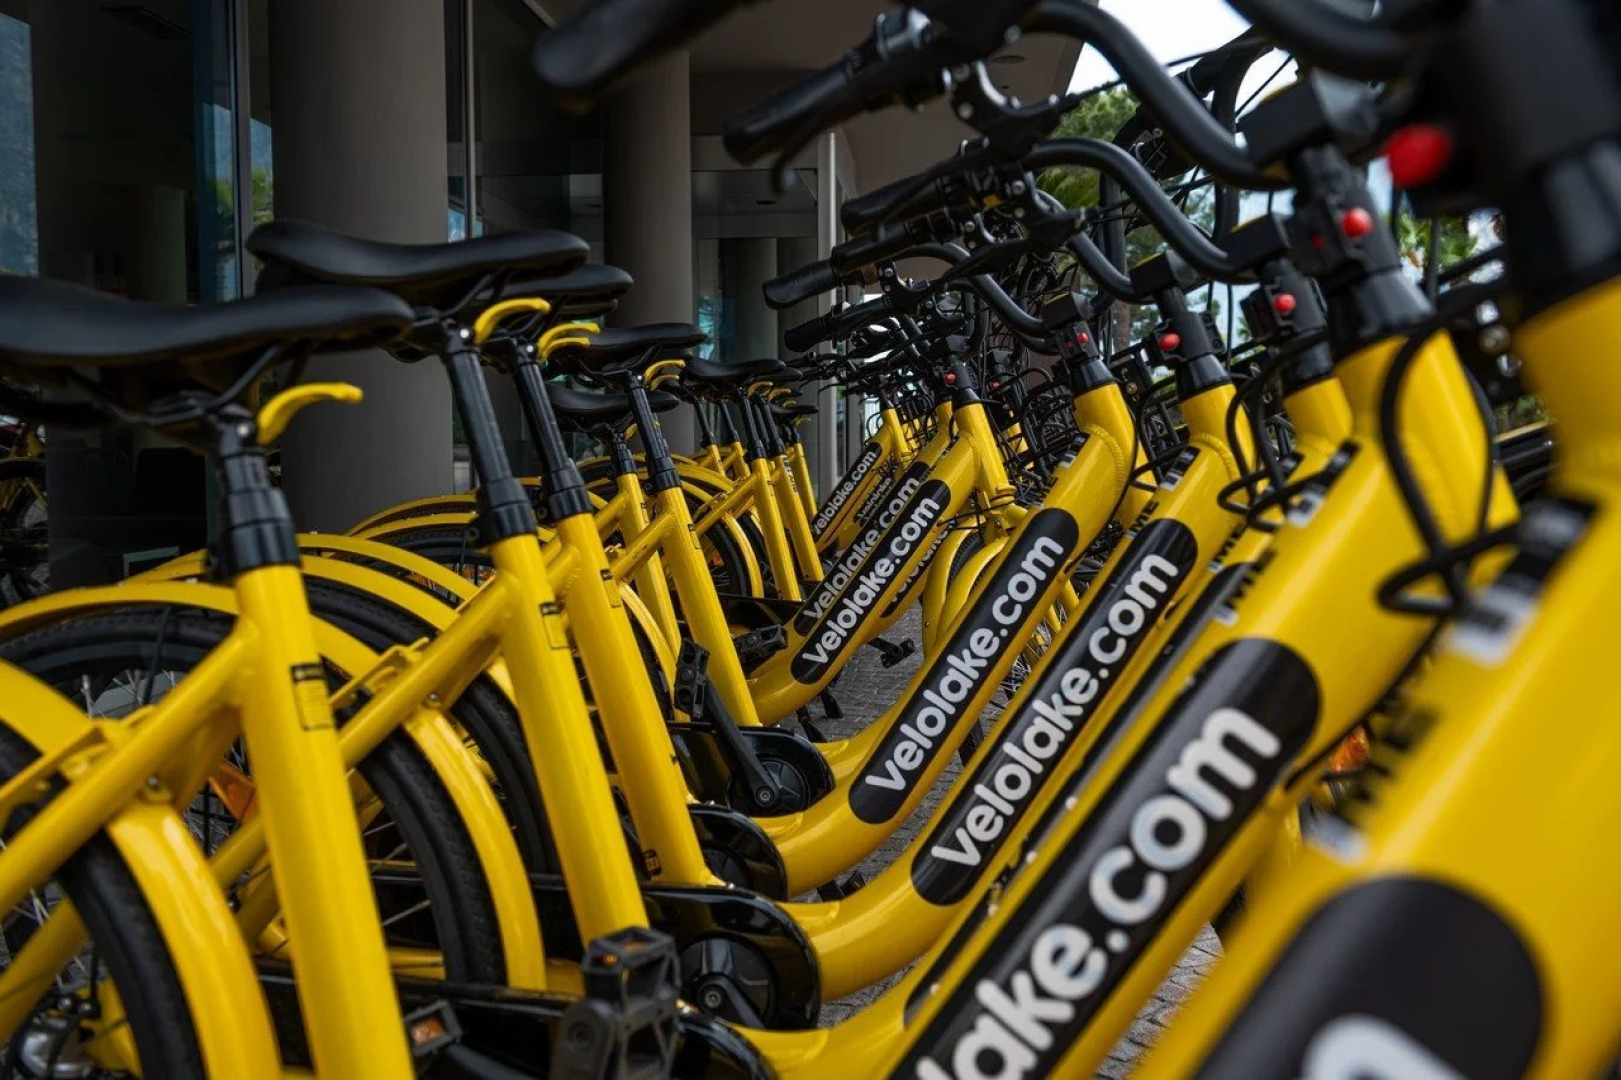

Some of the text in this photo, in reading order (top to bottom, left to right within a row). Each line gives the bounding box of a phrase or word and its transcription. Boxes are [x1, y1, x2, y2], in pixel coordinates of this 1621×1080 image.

[803, 478, 920, 619] velolakecom
[803, 497, 941, 664] velolake.com
[865, 535, 1064, 792] velolake.com
[931, 553, 1179, 867] velolake.com
